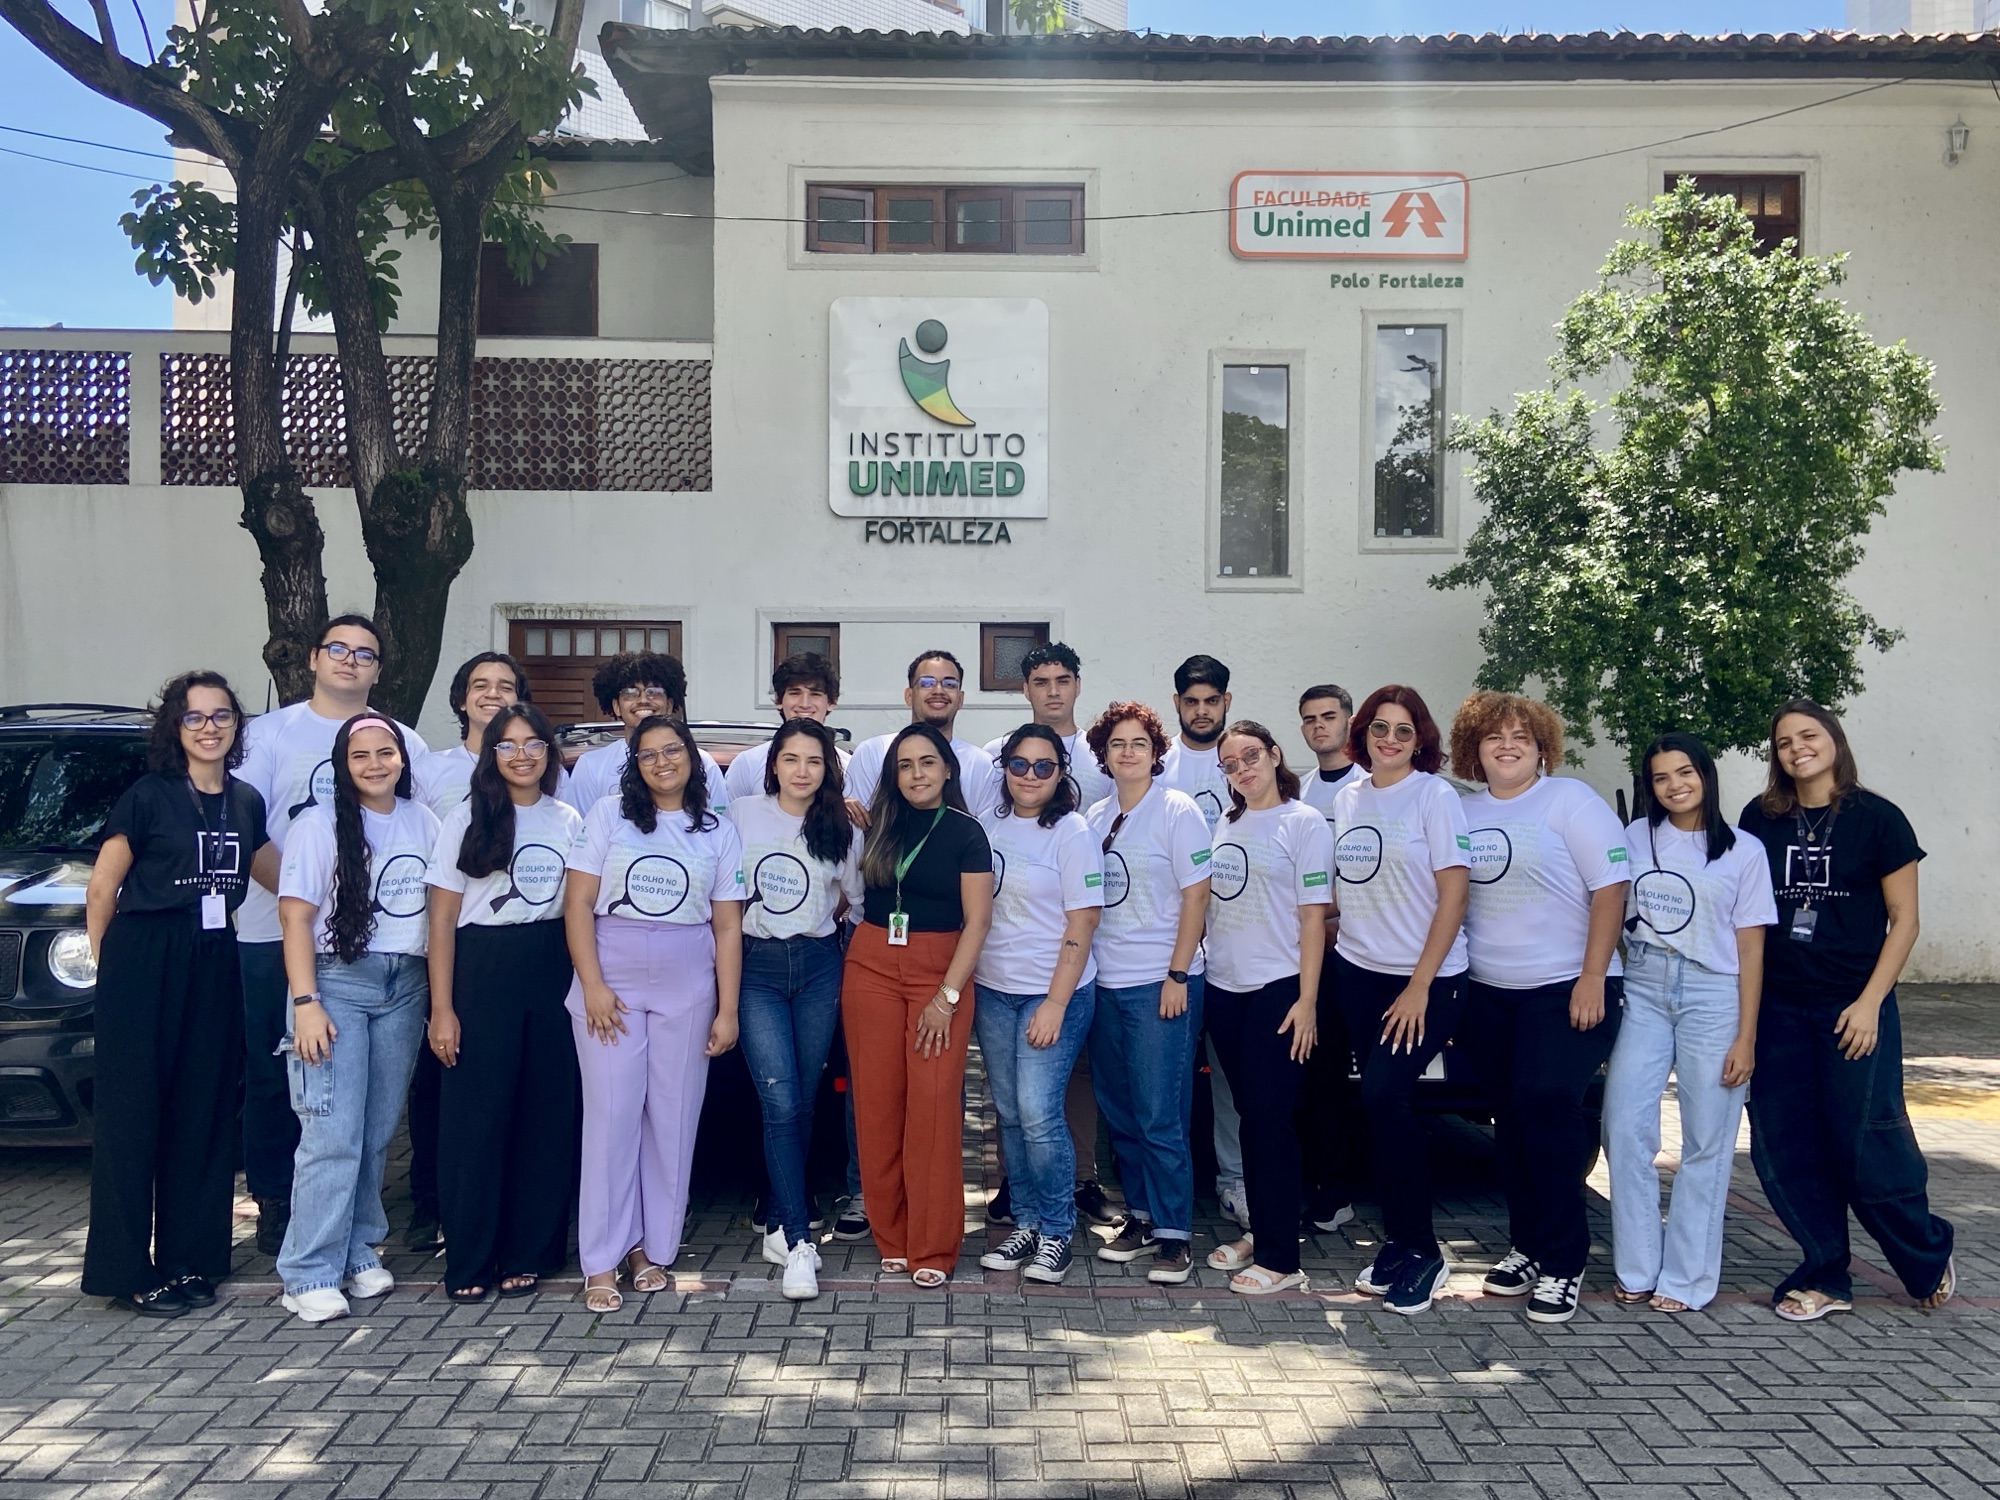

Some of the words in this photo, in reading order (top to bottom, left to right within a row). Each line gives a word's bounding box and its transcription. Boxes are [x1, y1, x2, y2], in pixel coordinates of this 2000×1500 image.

[1253, 190, 1371, 207] FACULDADE
[1253, 210, 1371, 238] Unimed
[1330, 273, 1370, 288] Polo
[1379, 273, 1464, 289] Fortaleza
[849, 432, 1026, 457] INSTITUTO
[848, 461, 1026, 497] UNIMED
[865, 520, 1012, 545] FORTALEZA
[1343, 844, 1361, 852] OLHO
[526, 865, 545, 873] OLHO
[1213, 861, 1230, 870] OLHO
[540, 876, 560, 884] FUTUR
[641, 875, 665, 884] OLHO
[666, 878, 677, 886] NO
[768, 872, 787, 883] OLHO
[787, 877, 798, 885] NO
[631, 884, 655, 894] NOSSO
[656, 888, 684, 897] FUTURO
[779, 887, 804, 896] FUTURO
[1646, 891, 1670, 901] OLHO
[1671, 896, 1683, 904] NO
[1662, 906, 1691, 916] FUTURO
